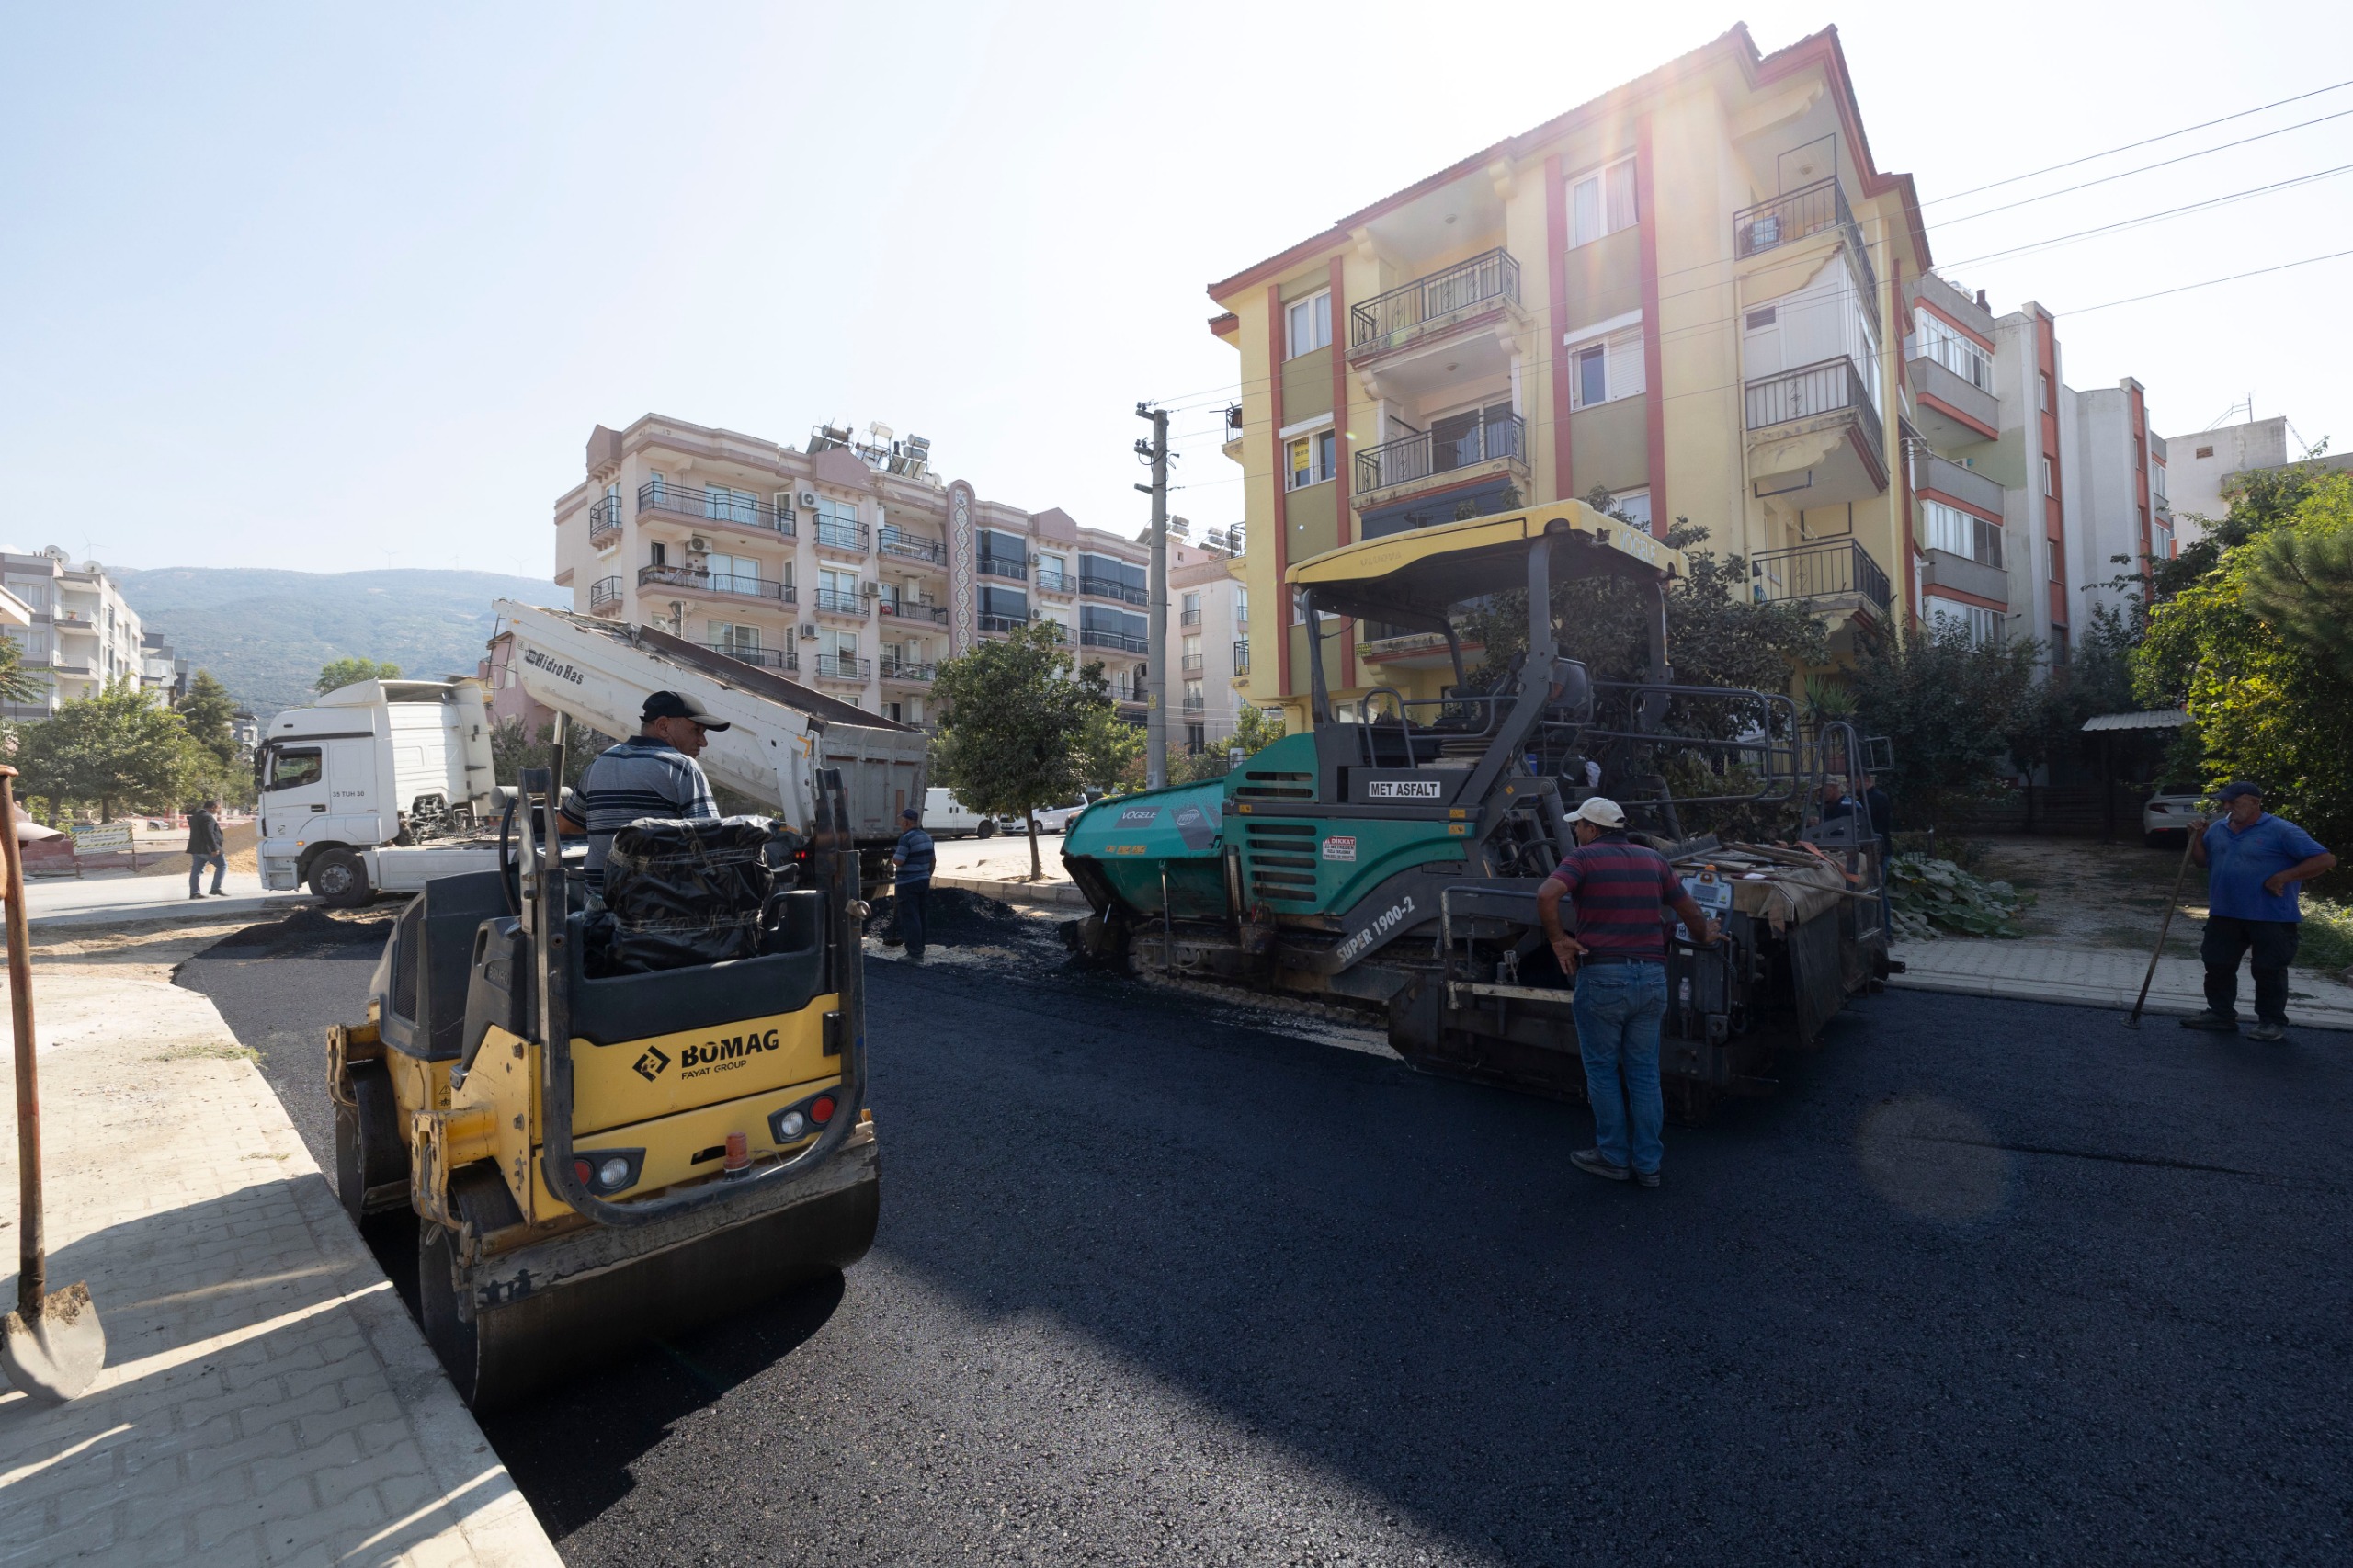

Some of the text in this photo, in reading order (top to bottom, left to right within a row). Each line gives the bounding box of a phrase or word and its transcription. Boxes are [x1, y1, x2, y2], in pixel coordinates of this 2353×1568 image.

[534, 653, 585, 686] Hidro Has
[1370, 783, 1438, 797] MET ASFALT
[1122, 810, 1159, 820] VÖGELE
[1336, 895, 1415, 964] SUPER 1900-2
[681, 1028, 779, 1069] BOMAG
[681, 1059, 747, 1081] FAYAT GROUP
